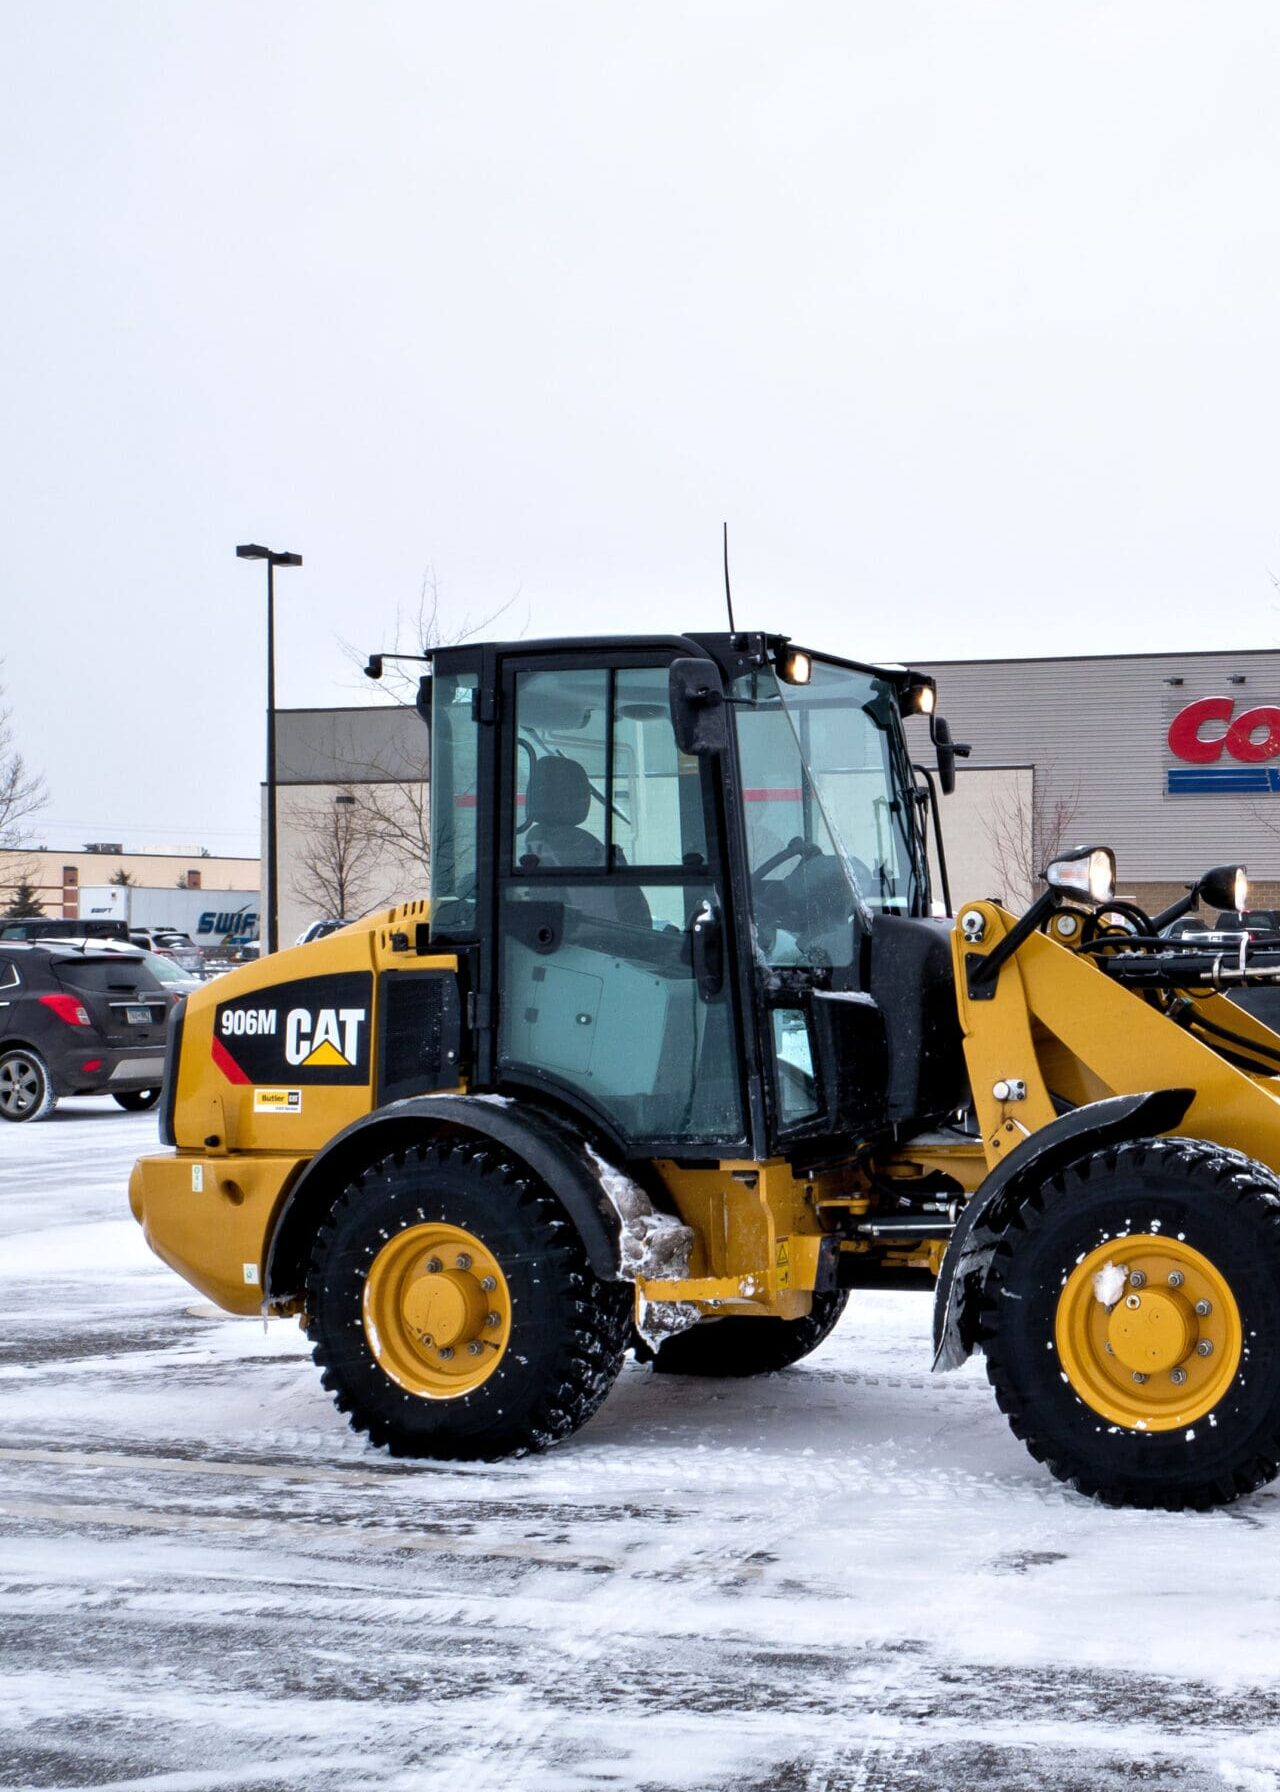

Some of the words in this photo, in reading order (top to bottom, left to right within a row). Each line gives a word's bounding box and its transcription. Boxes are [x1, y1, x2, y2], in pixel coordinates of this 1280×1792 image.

[197, 911, 260, 935] SWIF
[221, 1009, 277, 1036] 906M
[285, 1008, 366, 1066] CAT
[261, 1094, 285, 1102] Butler
